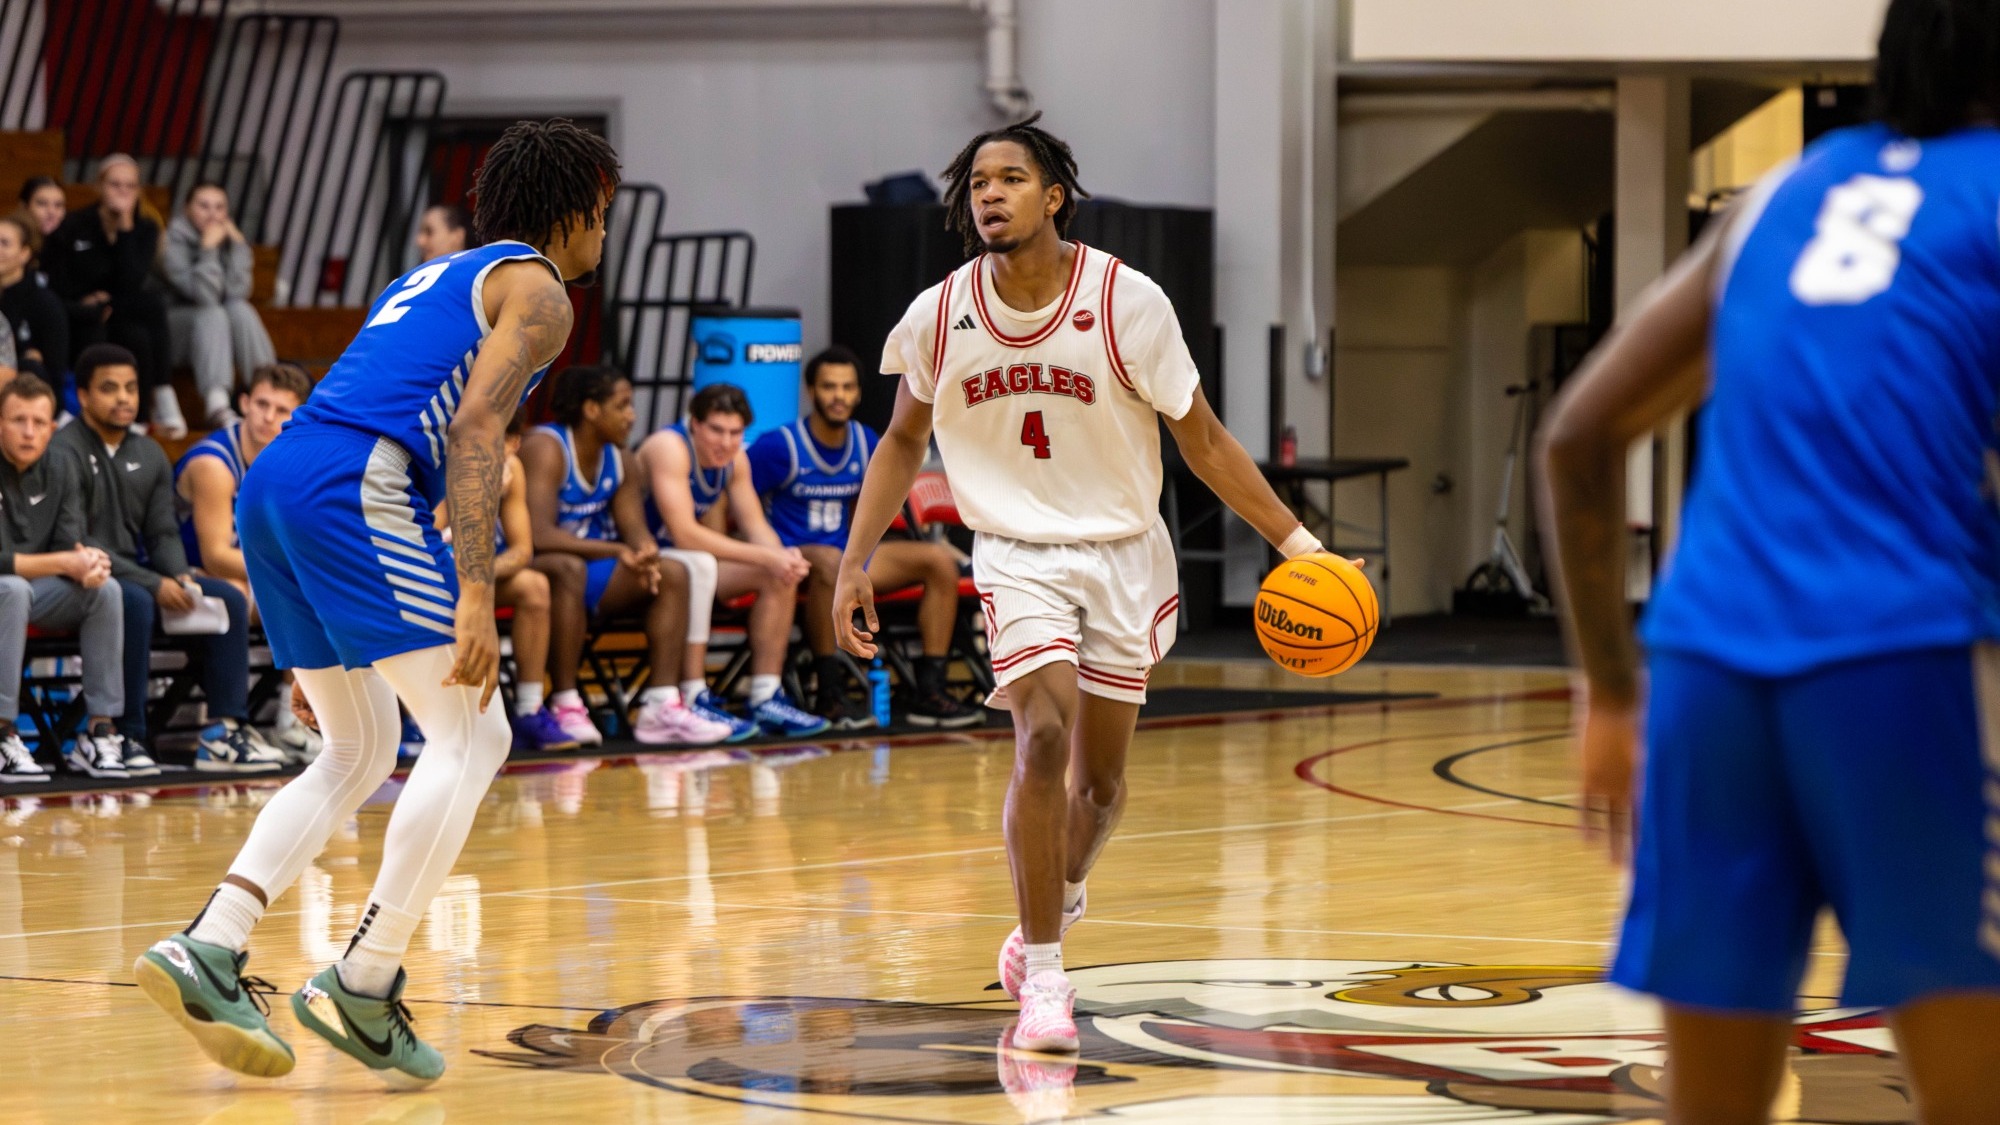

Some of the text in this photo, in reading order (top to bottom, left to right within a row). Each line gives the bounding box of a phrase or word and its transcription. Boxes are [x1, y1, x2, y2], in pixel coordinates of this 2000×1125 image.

[366, 262, 450, 329] 2
[962, 363, 1096, 408] EAGLES
[1021, 410, 1051, 459] 4
[1258, 598, 1324, 641] Wilson
